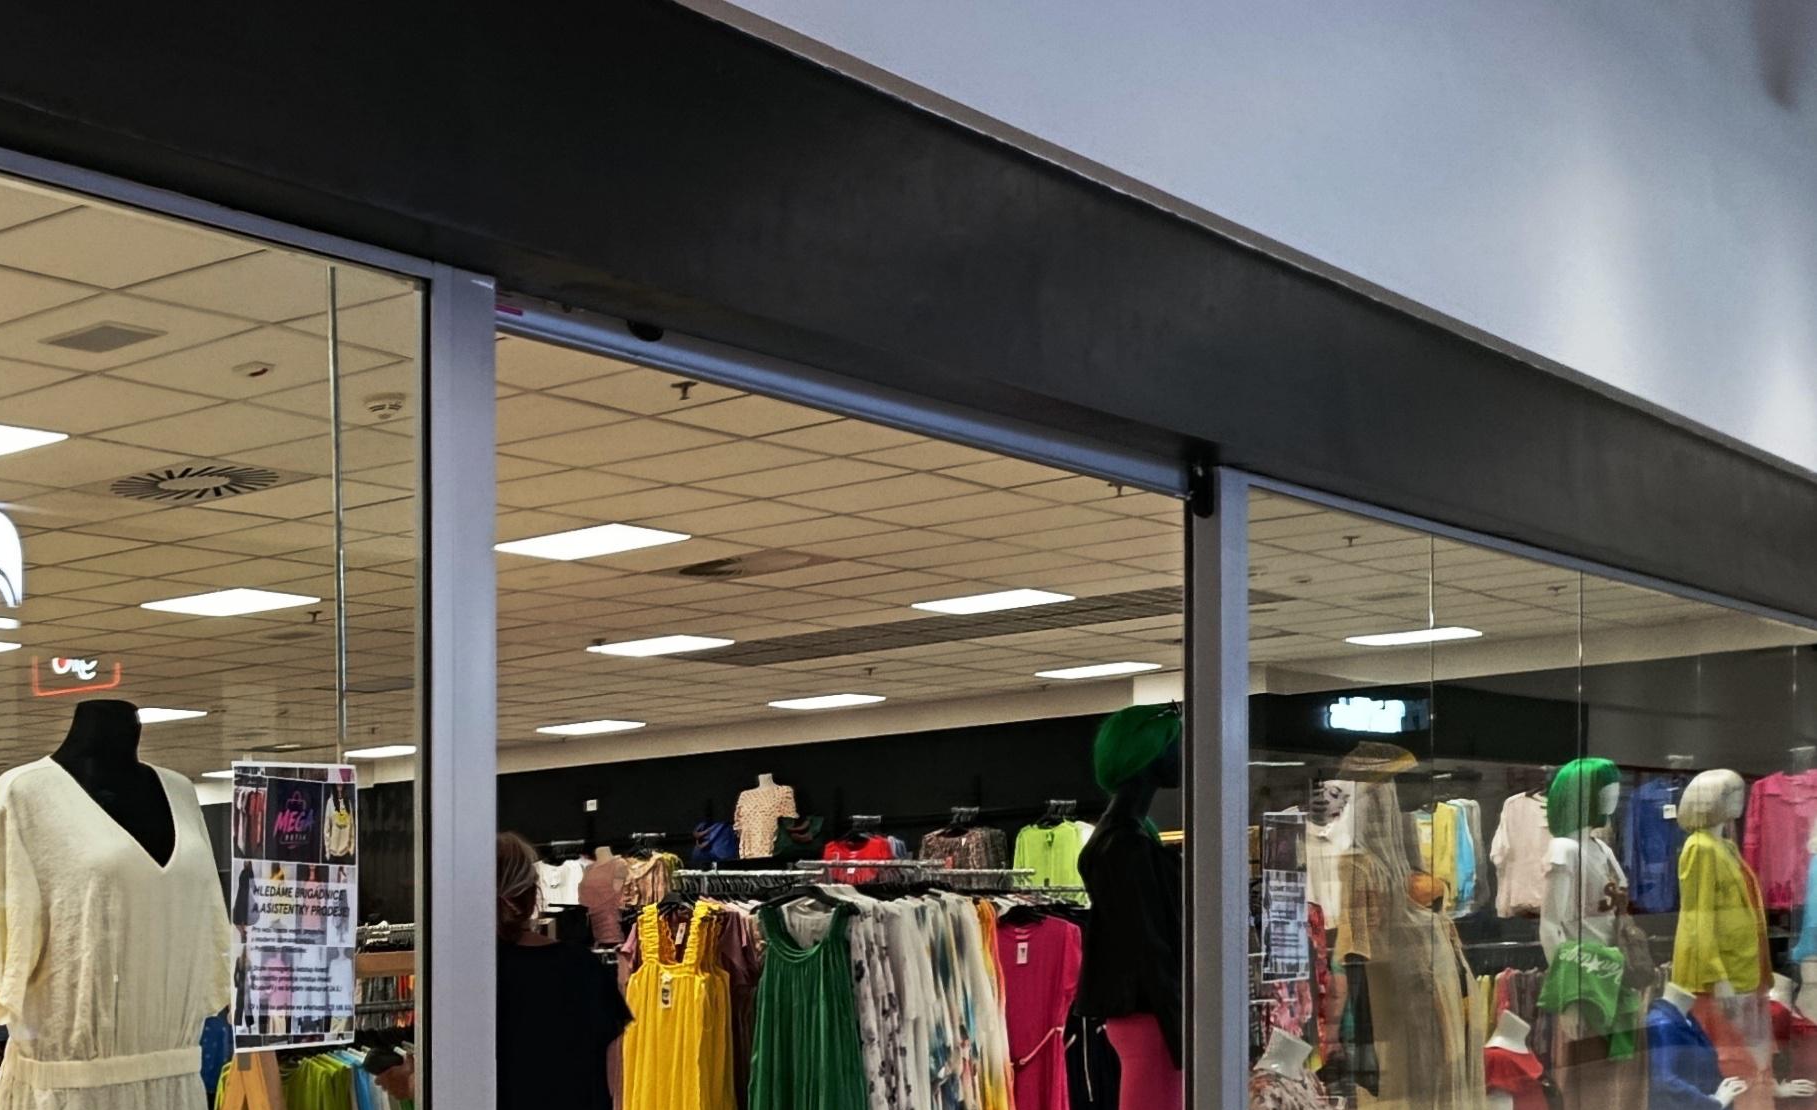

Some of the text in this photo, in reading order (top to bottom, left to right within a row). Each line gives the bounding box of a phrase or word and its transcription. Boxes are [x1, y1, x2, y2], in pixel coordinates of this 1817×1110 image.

[273, 809, 315, 837] MEGA
[253, 883, 293, 897] HLEDÁME
[261, 902, 309, 915] ASISTENTKY
